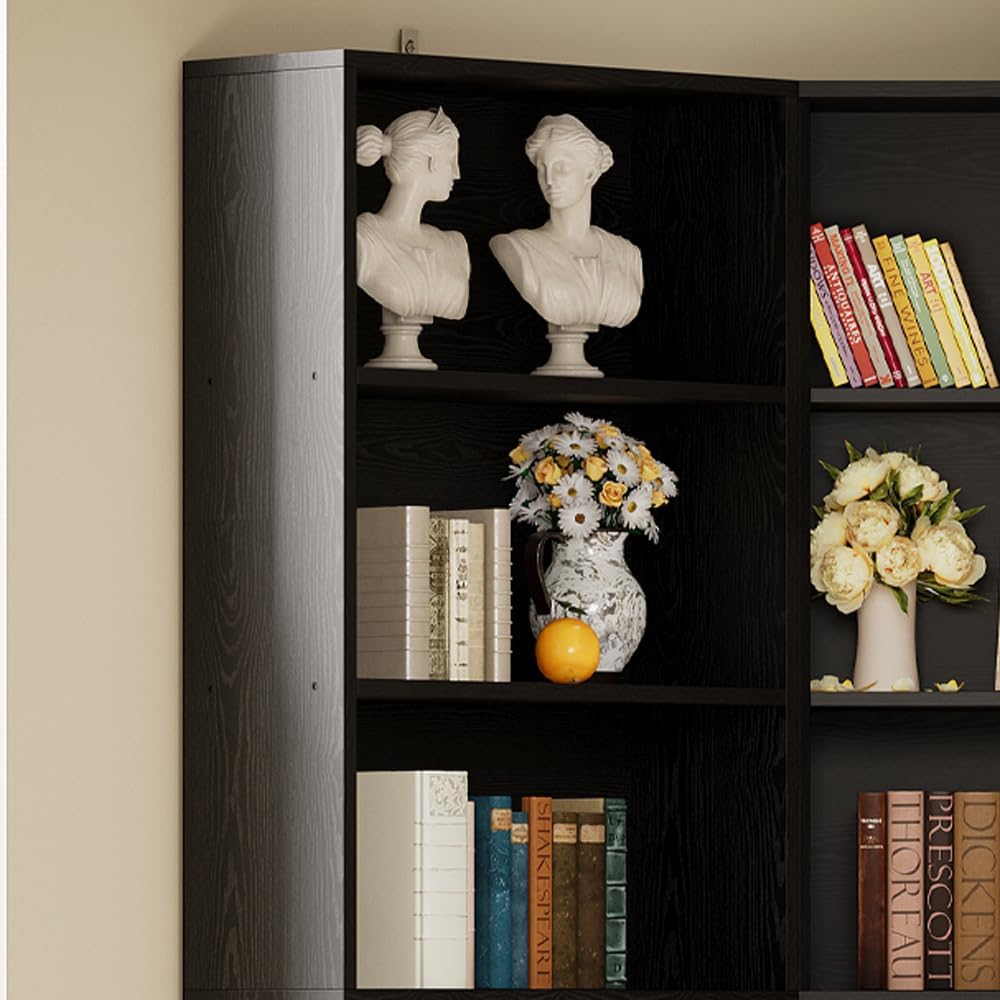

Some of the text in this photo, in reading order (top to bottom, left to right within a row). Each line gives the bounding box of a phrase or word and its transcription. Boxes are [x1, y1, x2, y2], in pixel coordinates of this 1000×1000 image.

[867, 264, 888, 289] ART
[882, 256, 906, 298] FINE
[901, 305, 928, 367] WINES
[920, 271, 937, 293] ART
[536, 802, 551, 985] SHAKESPEARE
[891, 794, 922, 979] THOREAU
[927, 795, 953, 988] PRESCOTT
[961, 801, 996, 983] DICKENS
